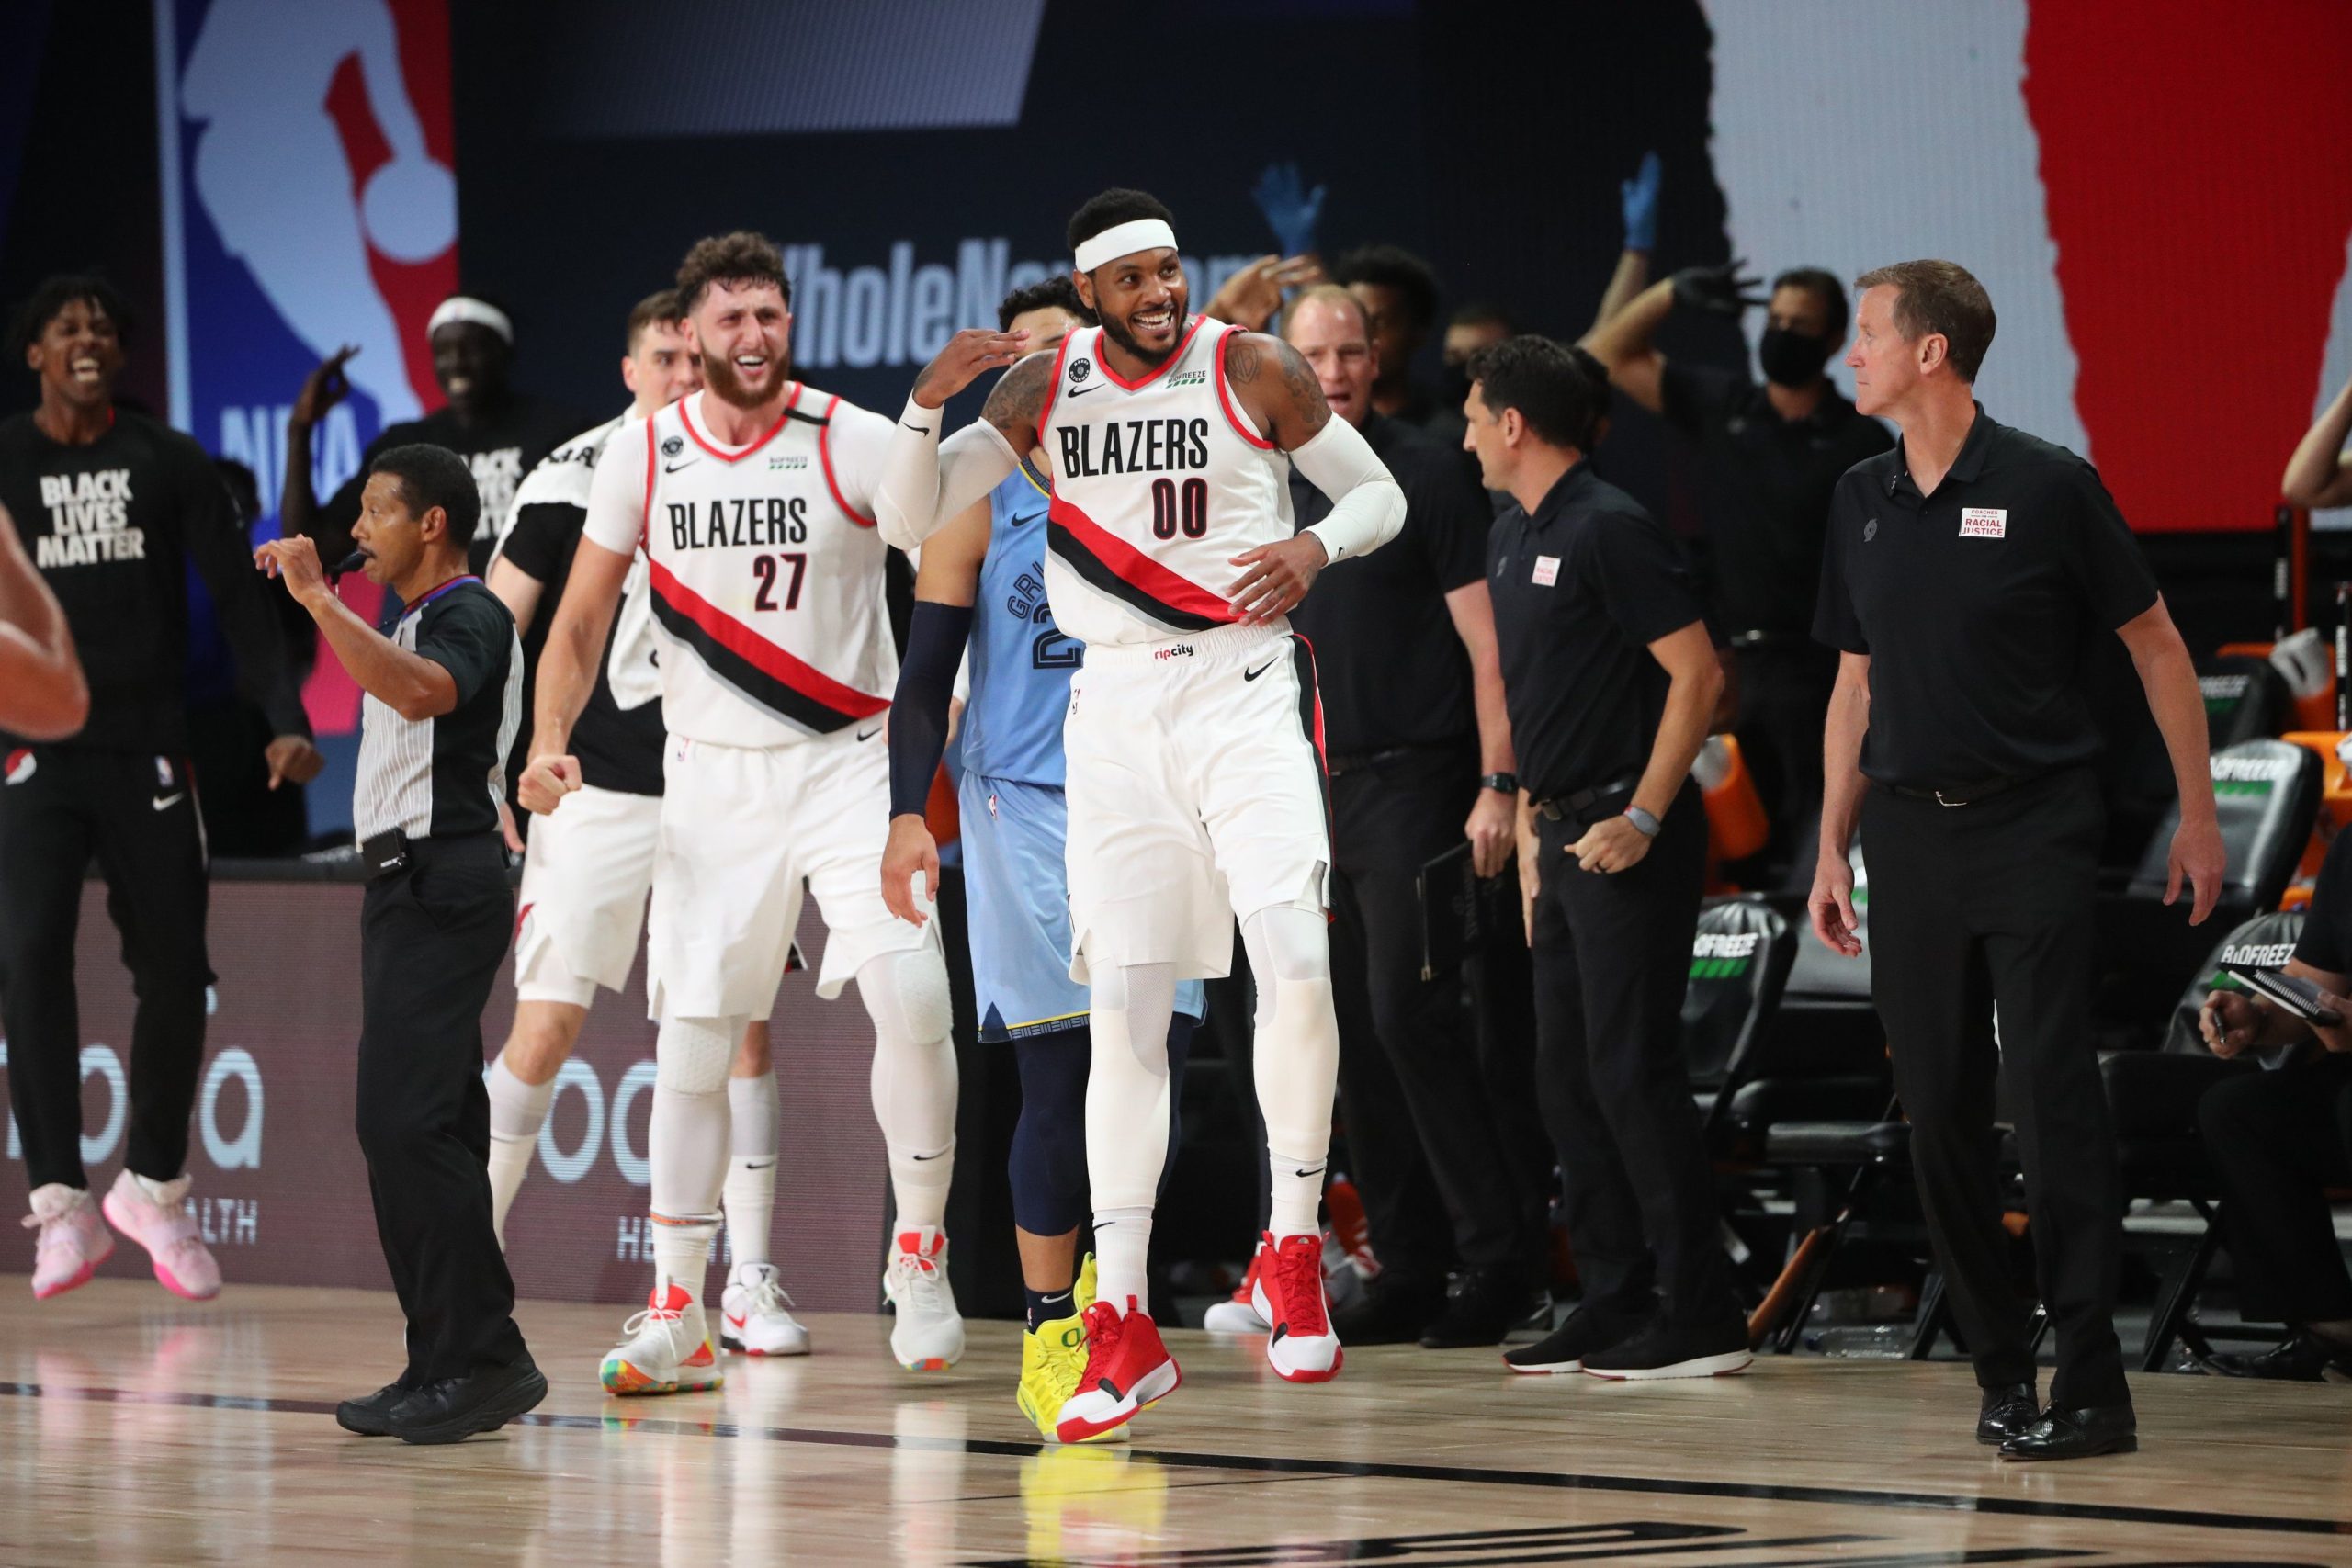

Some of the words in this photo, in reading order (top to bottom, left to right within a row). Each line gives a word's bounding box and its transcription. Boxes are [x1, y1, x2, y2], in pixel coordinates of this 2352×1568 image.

[1056, 418, 1209, 479] BLAZERS
[40, 468, 134, 508] BLACK
[1151, 477, 1208, 540] 00
[52, 499, 129, 536] LIVES
[666, 497, 808, 551] BLAZERS
[1962, 527, 2004, 536] JUSTICE
[1965, 518, 2002, 527] RACIAL
[37, 527, 146, 569] MATTER
[752, 553, 807, 612] 27
[2221, 942, 2297, 967] BIOFREEZ
